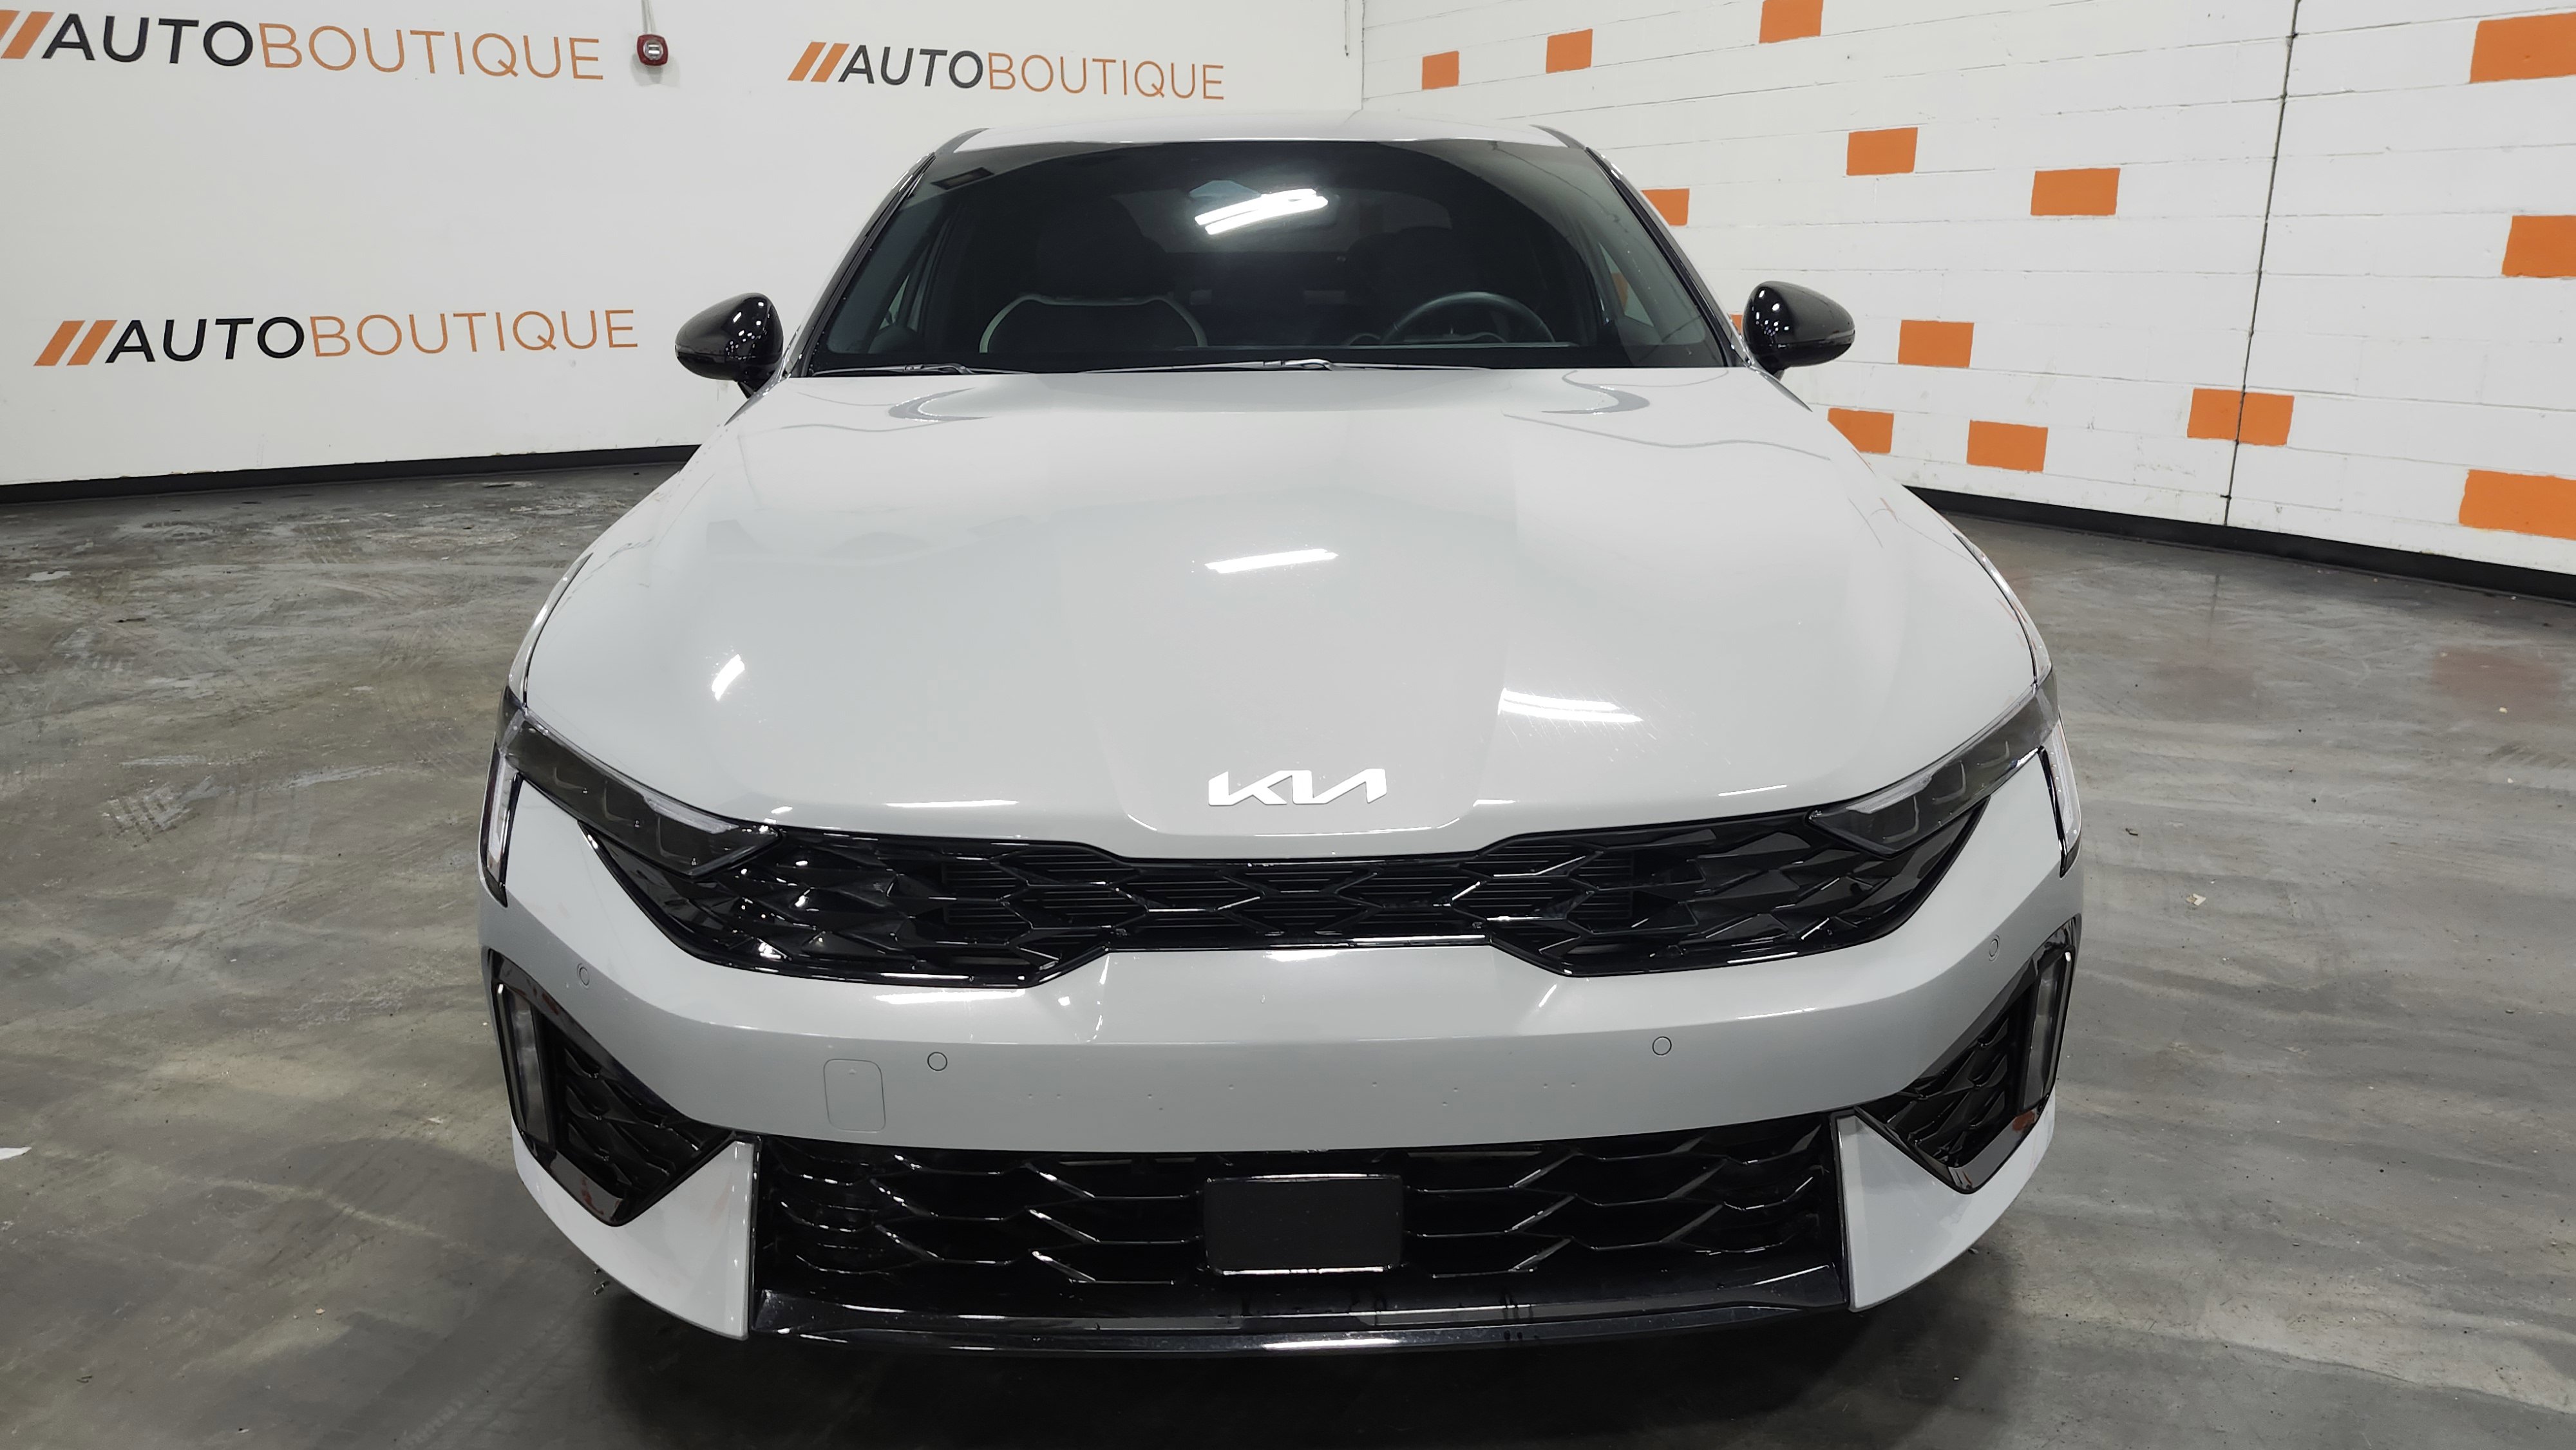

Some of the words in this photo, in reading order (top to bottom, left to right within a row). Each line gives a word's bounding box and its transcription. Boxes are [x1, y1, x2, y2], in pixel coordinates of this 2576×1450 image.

[42, 13, 603, 80] AUTOBOUTIQUE
[839, 45, 1224, 100] AUTOBOUTIQUE
[105, 309, 638, 366] AUTOBOUTIQUE
[1208, 768, 1387, 807] KIA
